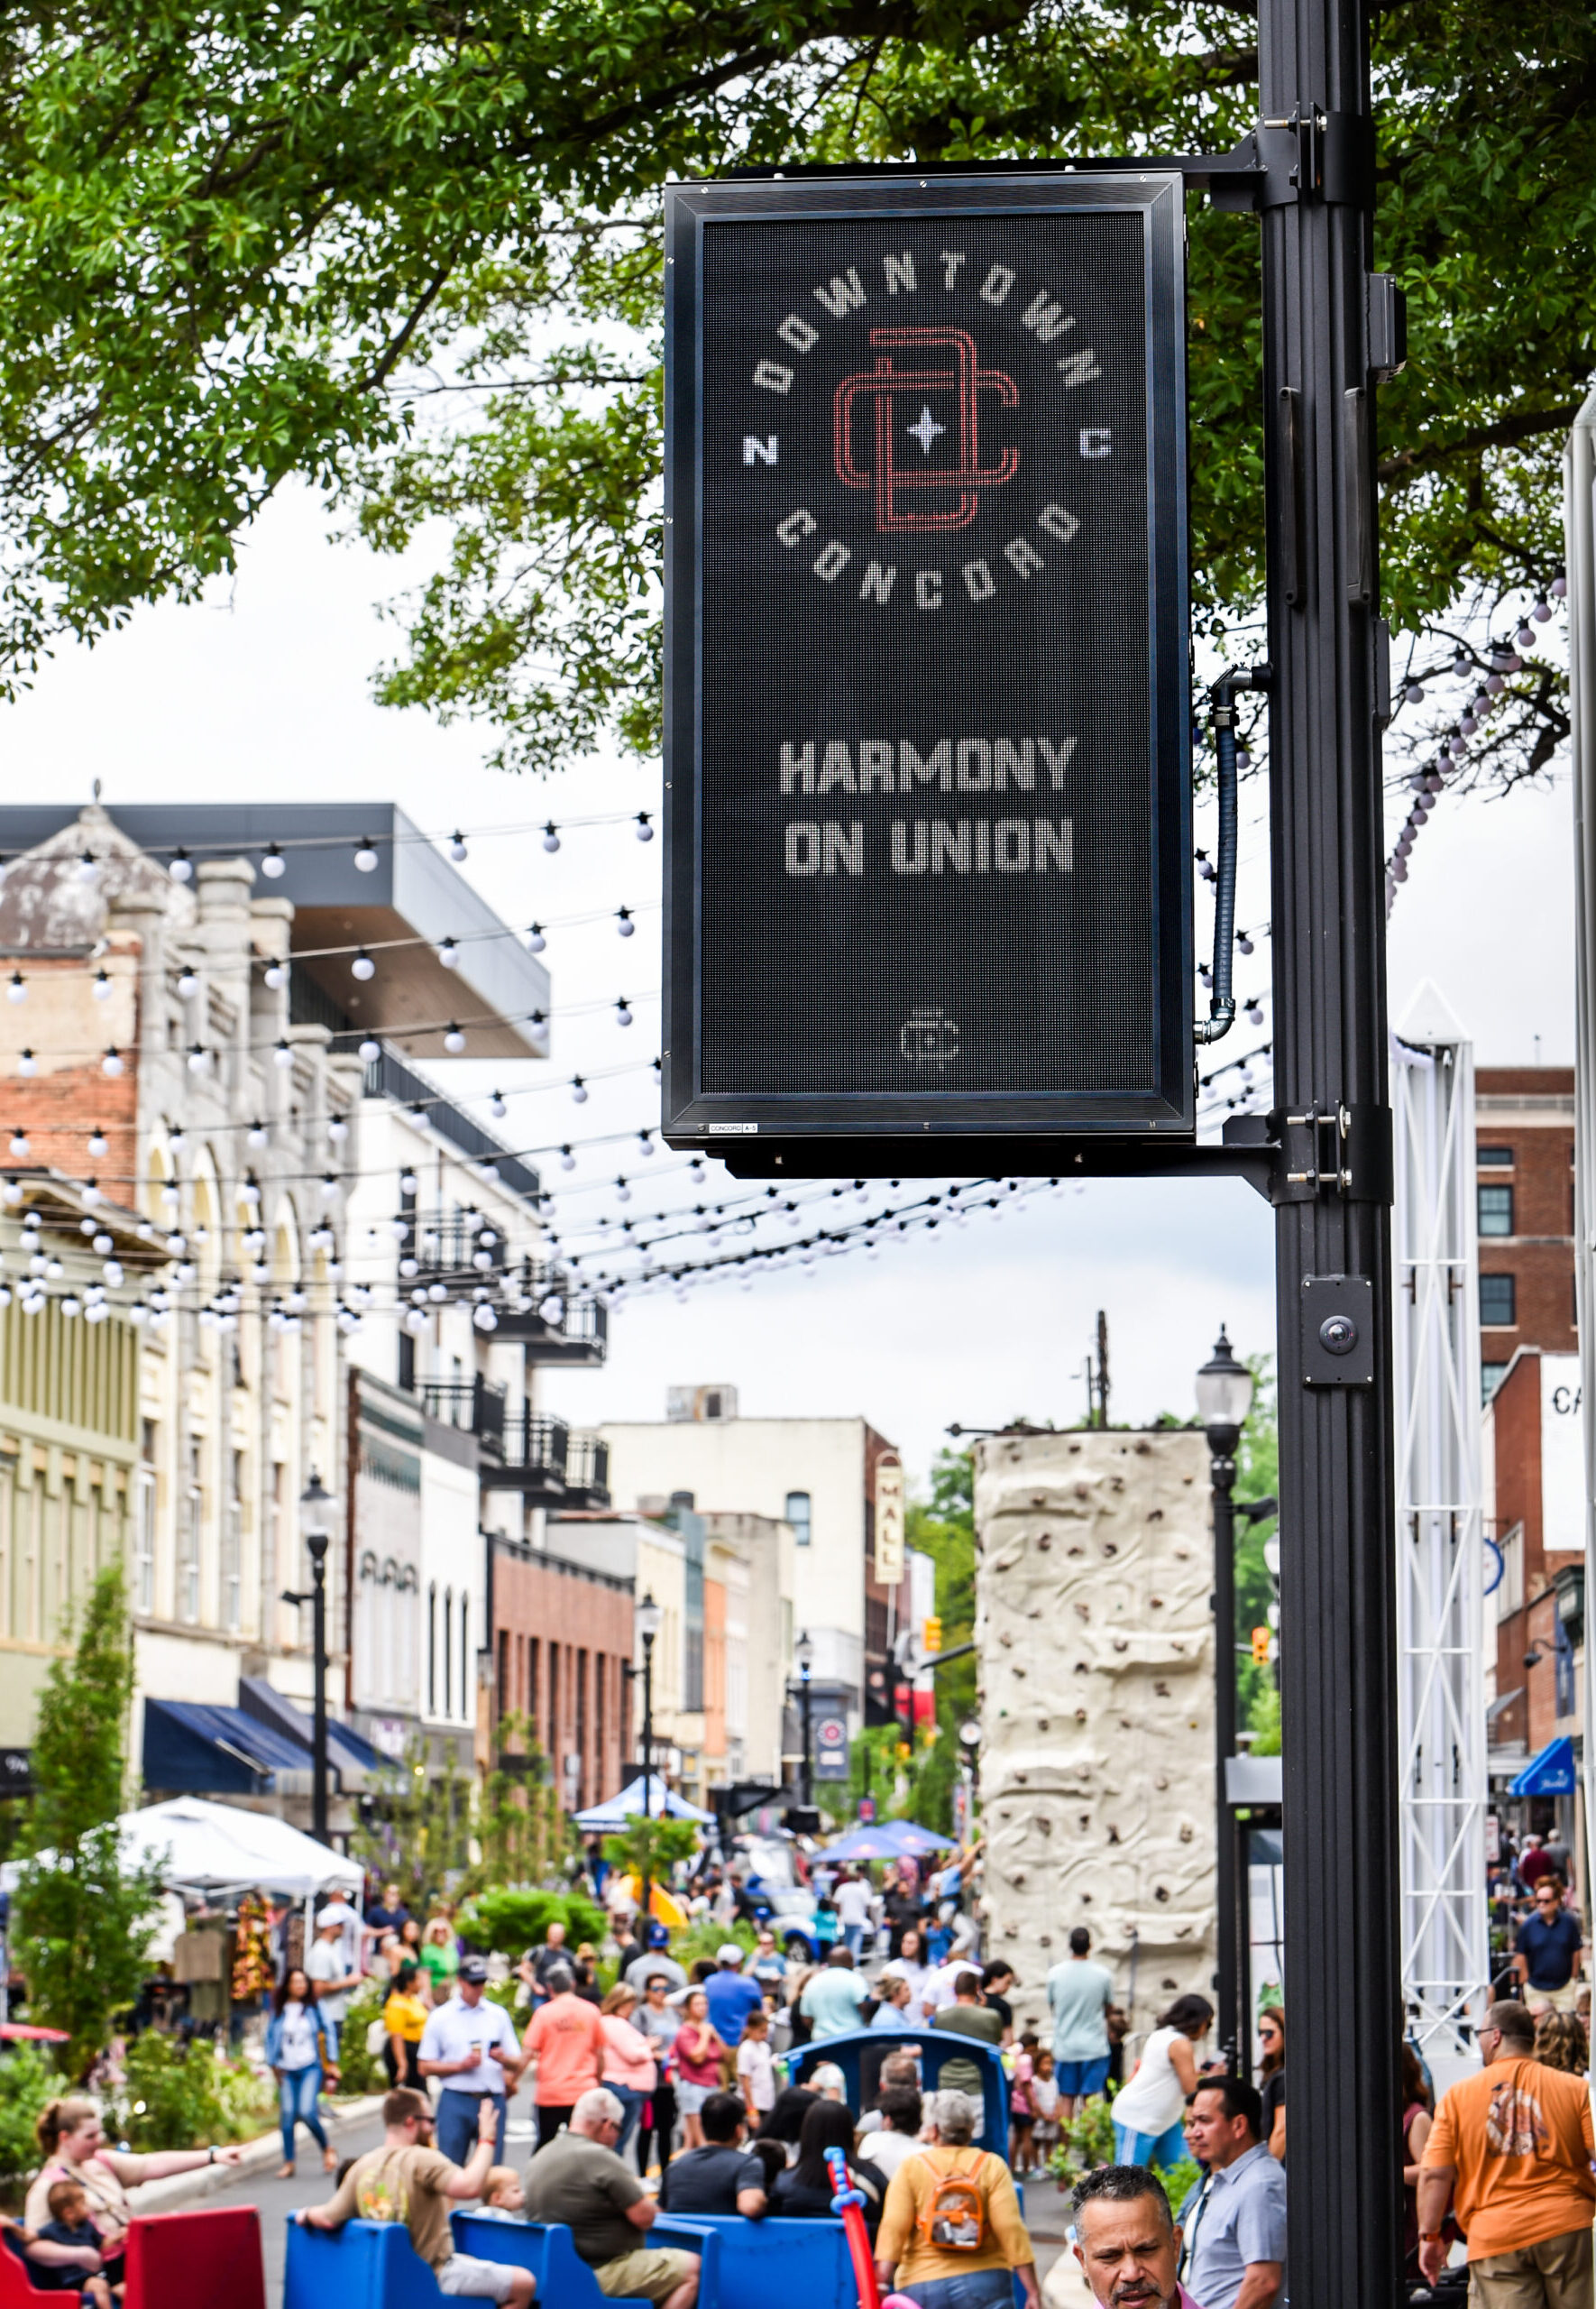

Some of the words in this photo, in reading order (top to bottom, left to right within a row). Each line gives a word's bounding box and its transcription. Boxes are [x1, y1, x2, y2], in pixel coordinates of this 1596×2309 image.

[754, 251, 1102, 393] DOWNTOWN
[776, 504, 1080, 610] CONCORD
[780, 737, 1078, 794] HARMONY
[784, 822, 864, 876] ON
[891, 818, 1073, 874] UNION
[882, 1486, 898, 1566] MALL
